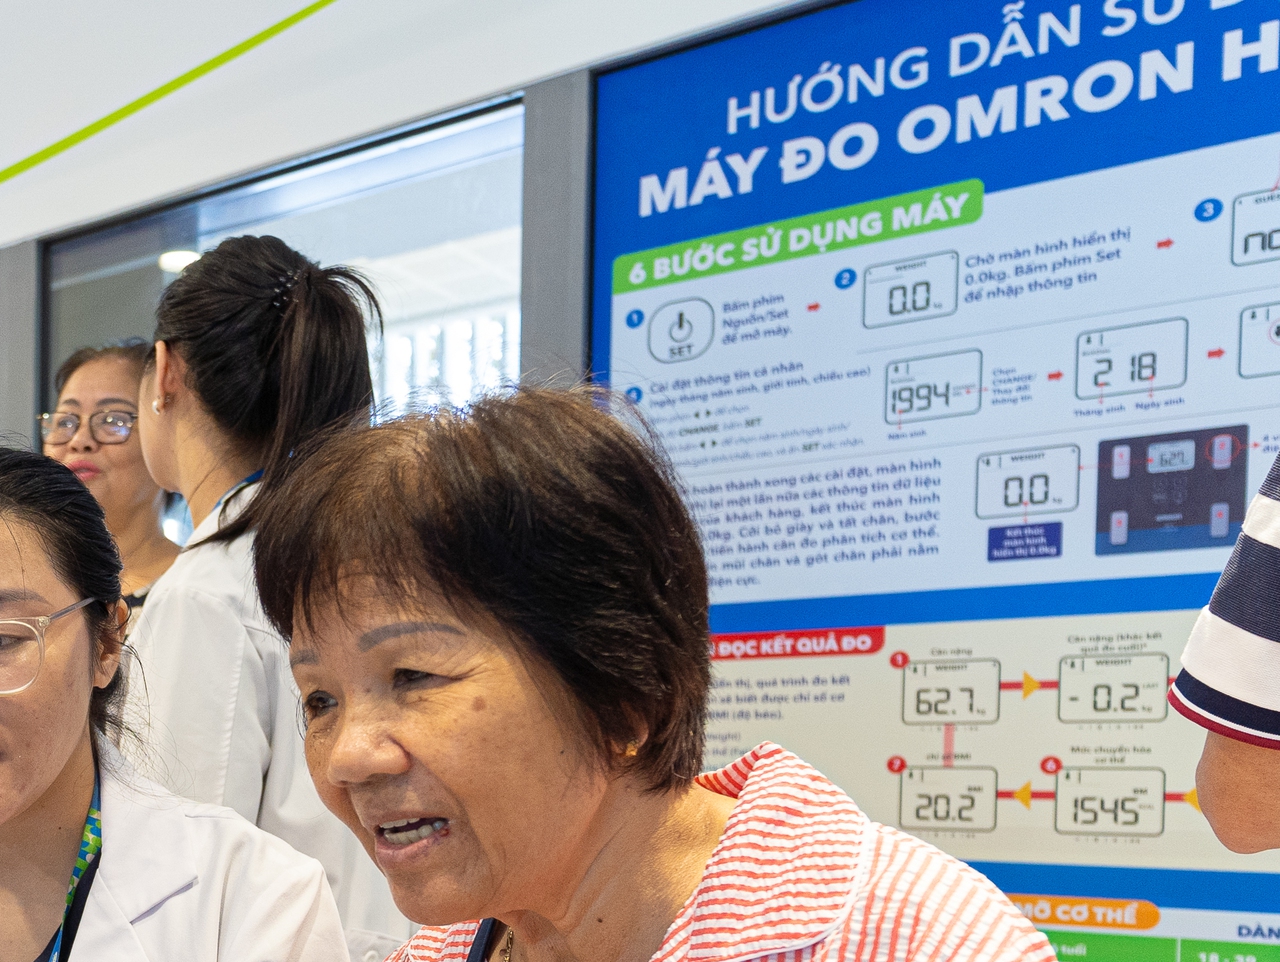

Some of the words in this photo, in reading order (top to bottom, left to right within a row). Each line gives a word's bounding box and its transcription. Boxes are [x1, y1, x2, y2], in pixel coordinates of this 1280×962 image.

[727, 46, 929, 134] HƯỚNG
[949, 0, 1081, 77] DẪN
[638, 146, 769, 218] MÁY
[779, 122, 879, 184] ĐO
[897, 41, 1194, 155] OMRON
[629, 262, 647, 285] 6
[653, 242, 736, 280] BƯỚC
[741, 226, 783, 262] SỬ
[789, 211, 883, 253] DỤNG
[892, 192, 969, 231] MÁY
[1096, 248, 1122, 262] Set
[888, 281, 931, 316] 0.0
[1094, 358, 1112, 387] 2
[1130, 352, 1157, 383] 18
[891, 381, 950, 414] 1994
[720, 640, 758, 660] ĐỌC
[760, 634, 795, 655] KẾT
[796, 631, 840, 653] QUẢ
[841, 634, 872, 651] ĐO
[916, 687, 974, 715] 62.7
[1093, 683, 1139, 712] 0.2
[915, 793, 976, 822] 20.2
[1073, 796, 1139, 826] 1545
